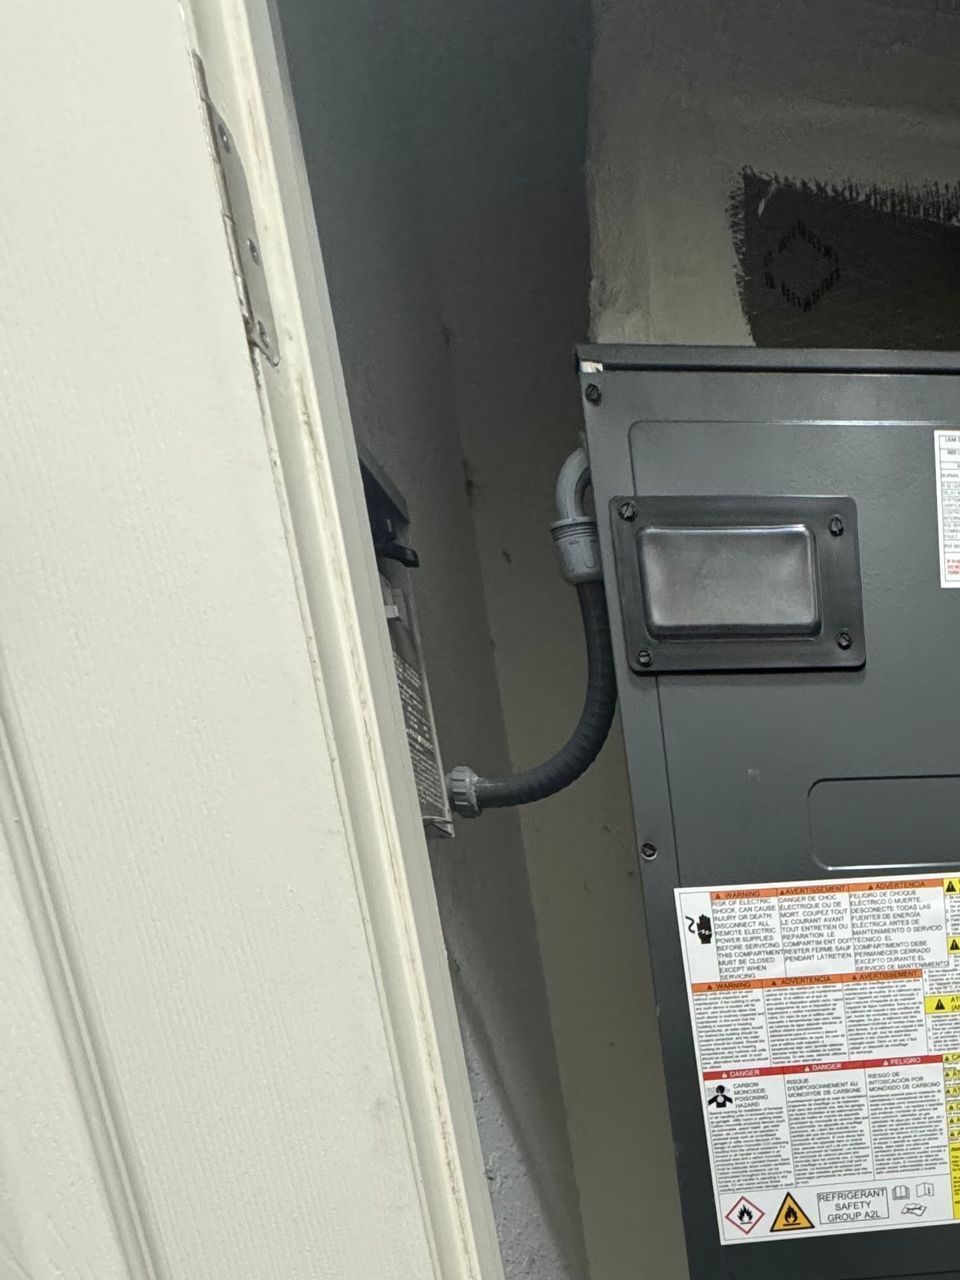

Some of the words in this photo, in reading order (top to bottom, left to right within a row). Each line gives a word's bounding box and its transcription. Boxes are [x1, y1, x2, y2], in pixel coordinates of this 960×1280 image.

[859, 970, 917, 980] AVERTISSEMENT
[716, 981, 751, 989] WARNING
[781, 976, 831, 985] ADVERTENCIA
[890, 1057, 921, 1065] PELIGRO
[812, 1063, 842, 1071] DANGER
[729, 1069, 760, 1077] DANGER
[818, 1188, 885, 1202] REFRIGERANT
[834, 1200, 871, 1211] SAFETY
[826, 1211, 861, 1222] GROUP
[864, 1209, 880, 1219] A2L
